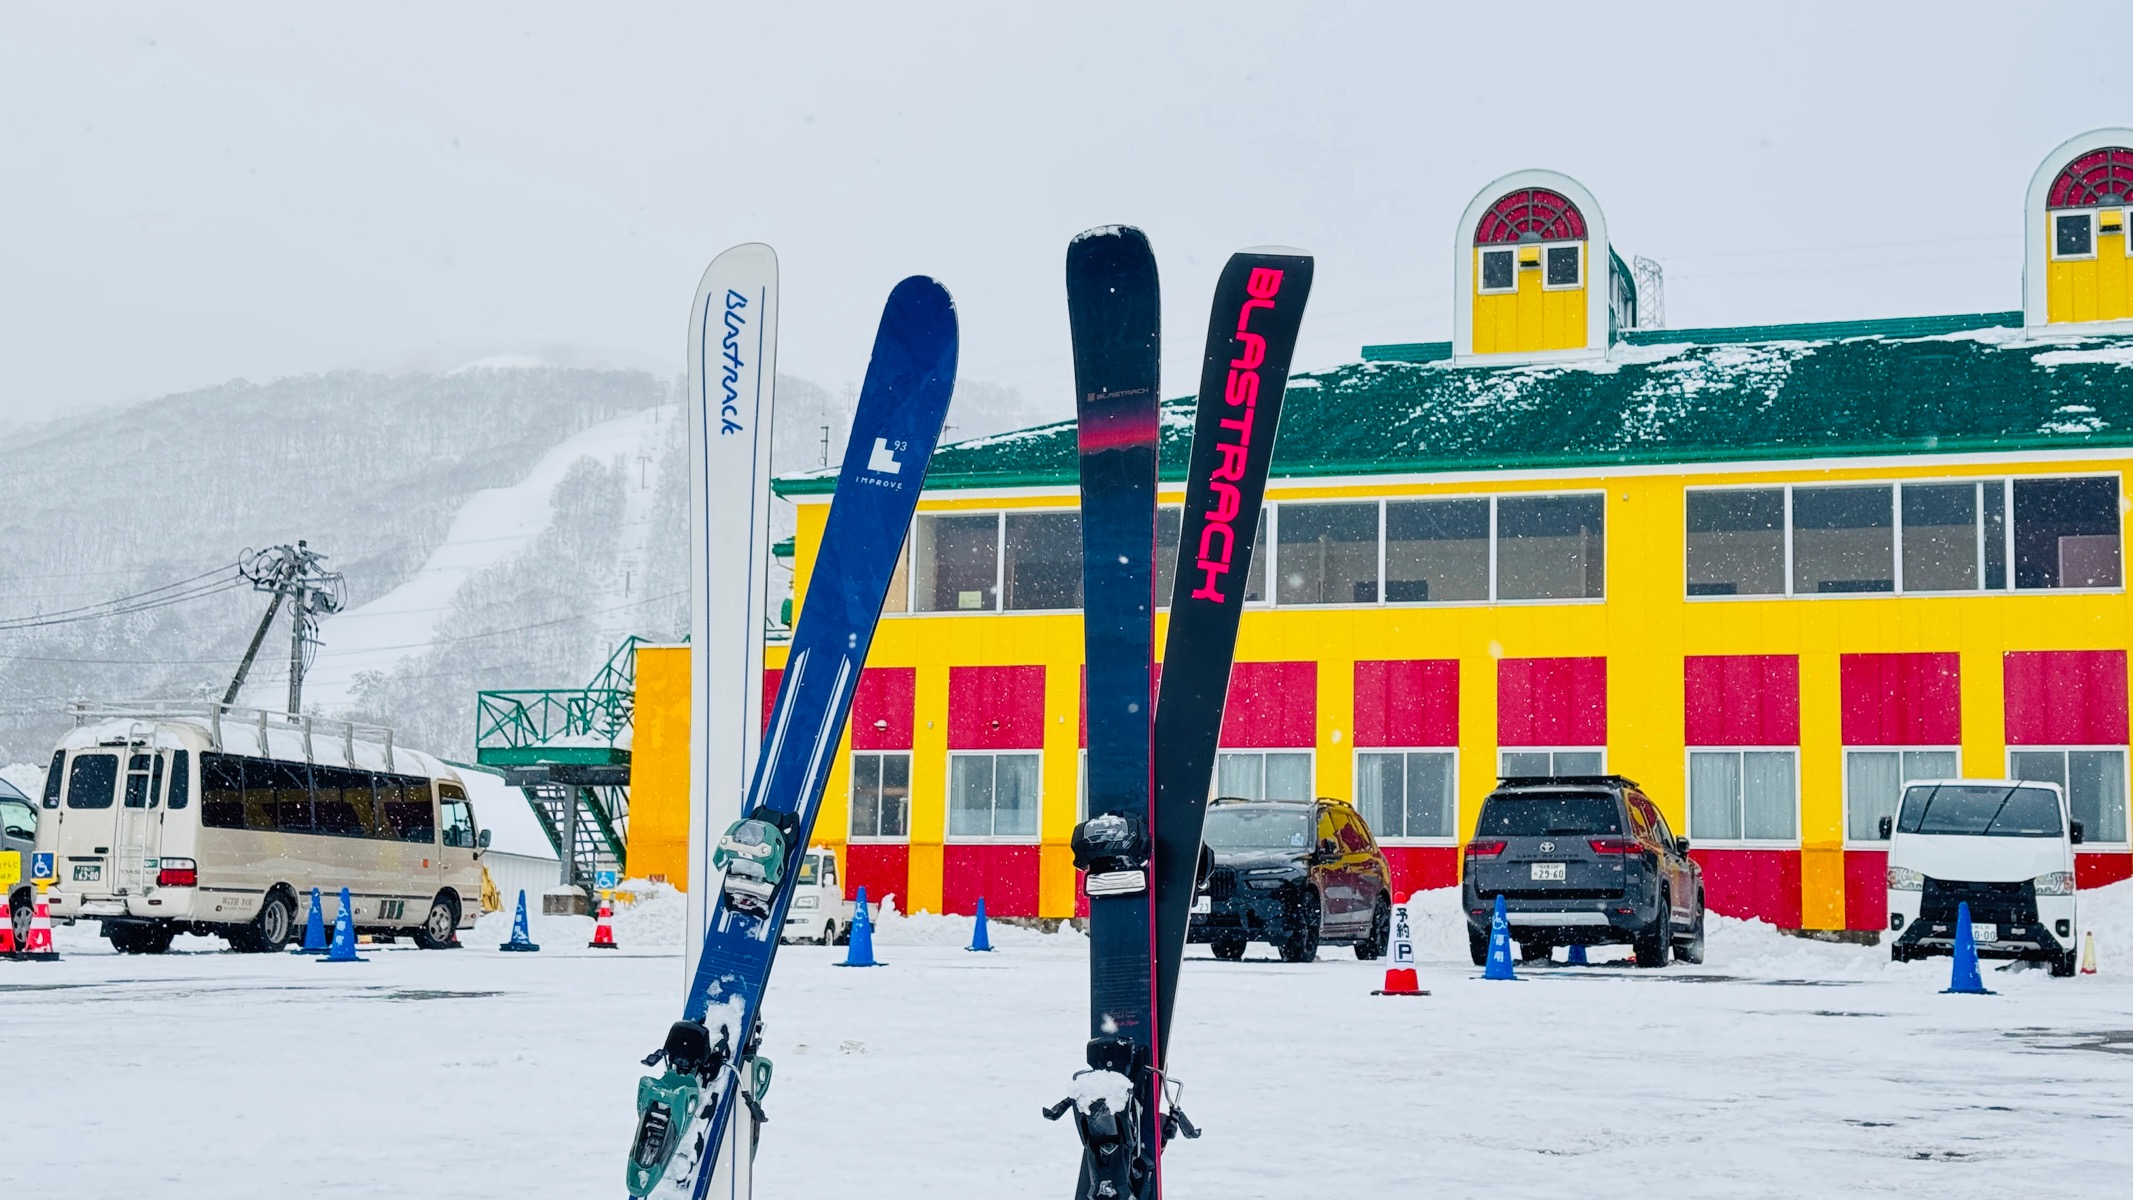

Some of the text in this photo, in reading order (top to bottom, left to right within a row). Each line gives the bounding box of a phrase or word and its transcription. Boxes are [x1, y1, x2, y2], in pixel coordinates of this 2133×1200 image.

[894, 440, 908, 452] 93
[1191, 267, 1284, 604] BLASTRACK
[855, 476, 903, 490] IMPROVE
[1396, 907, 1412, 960] 予約 P
